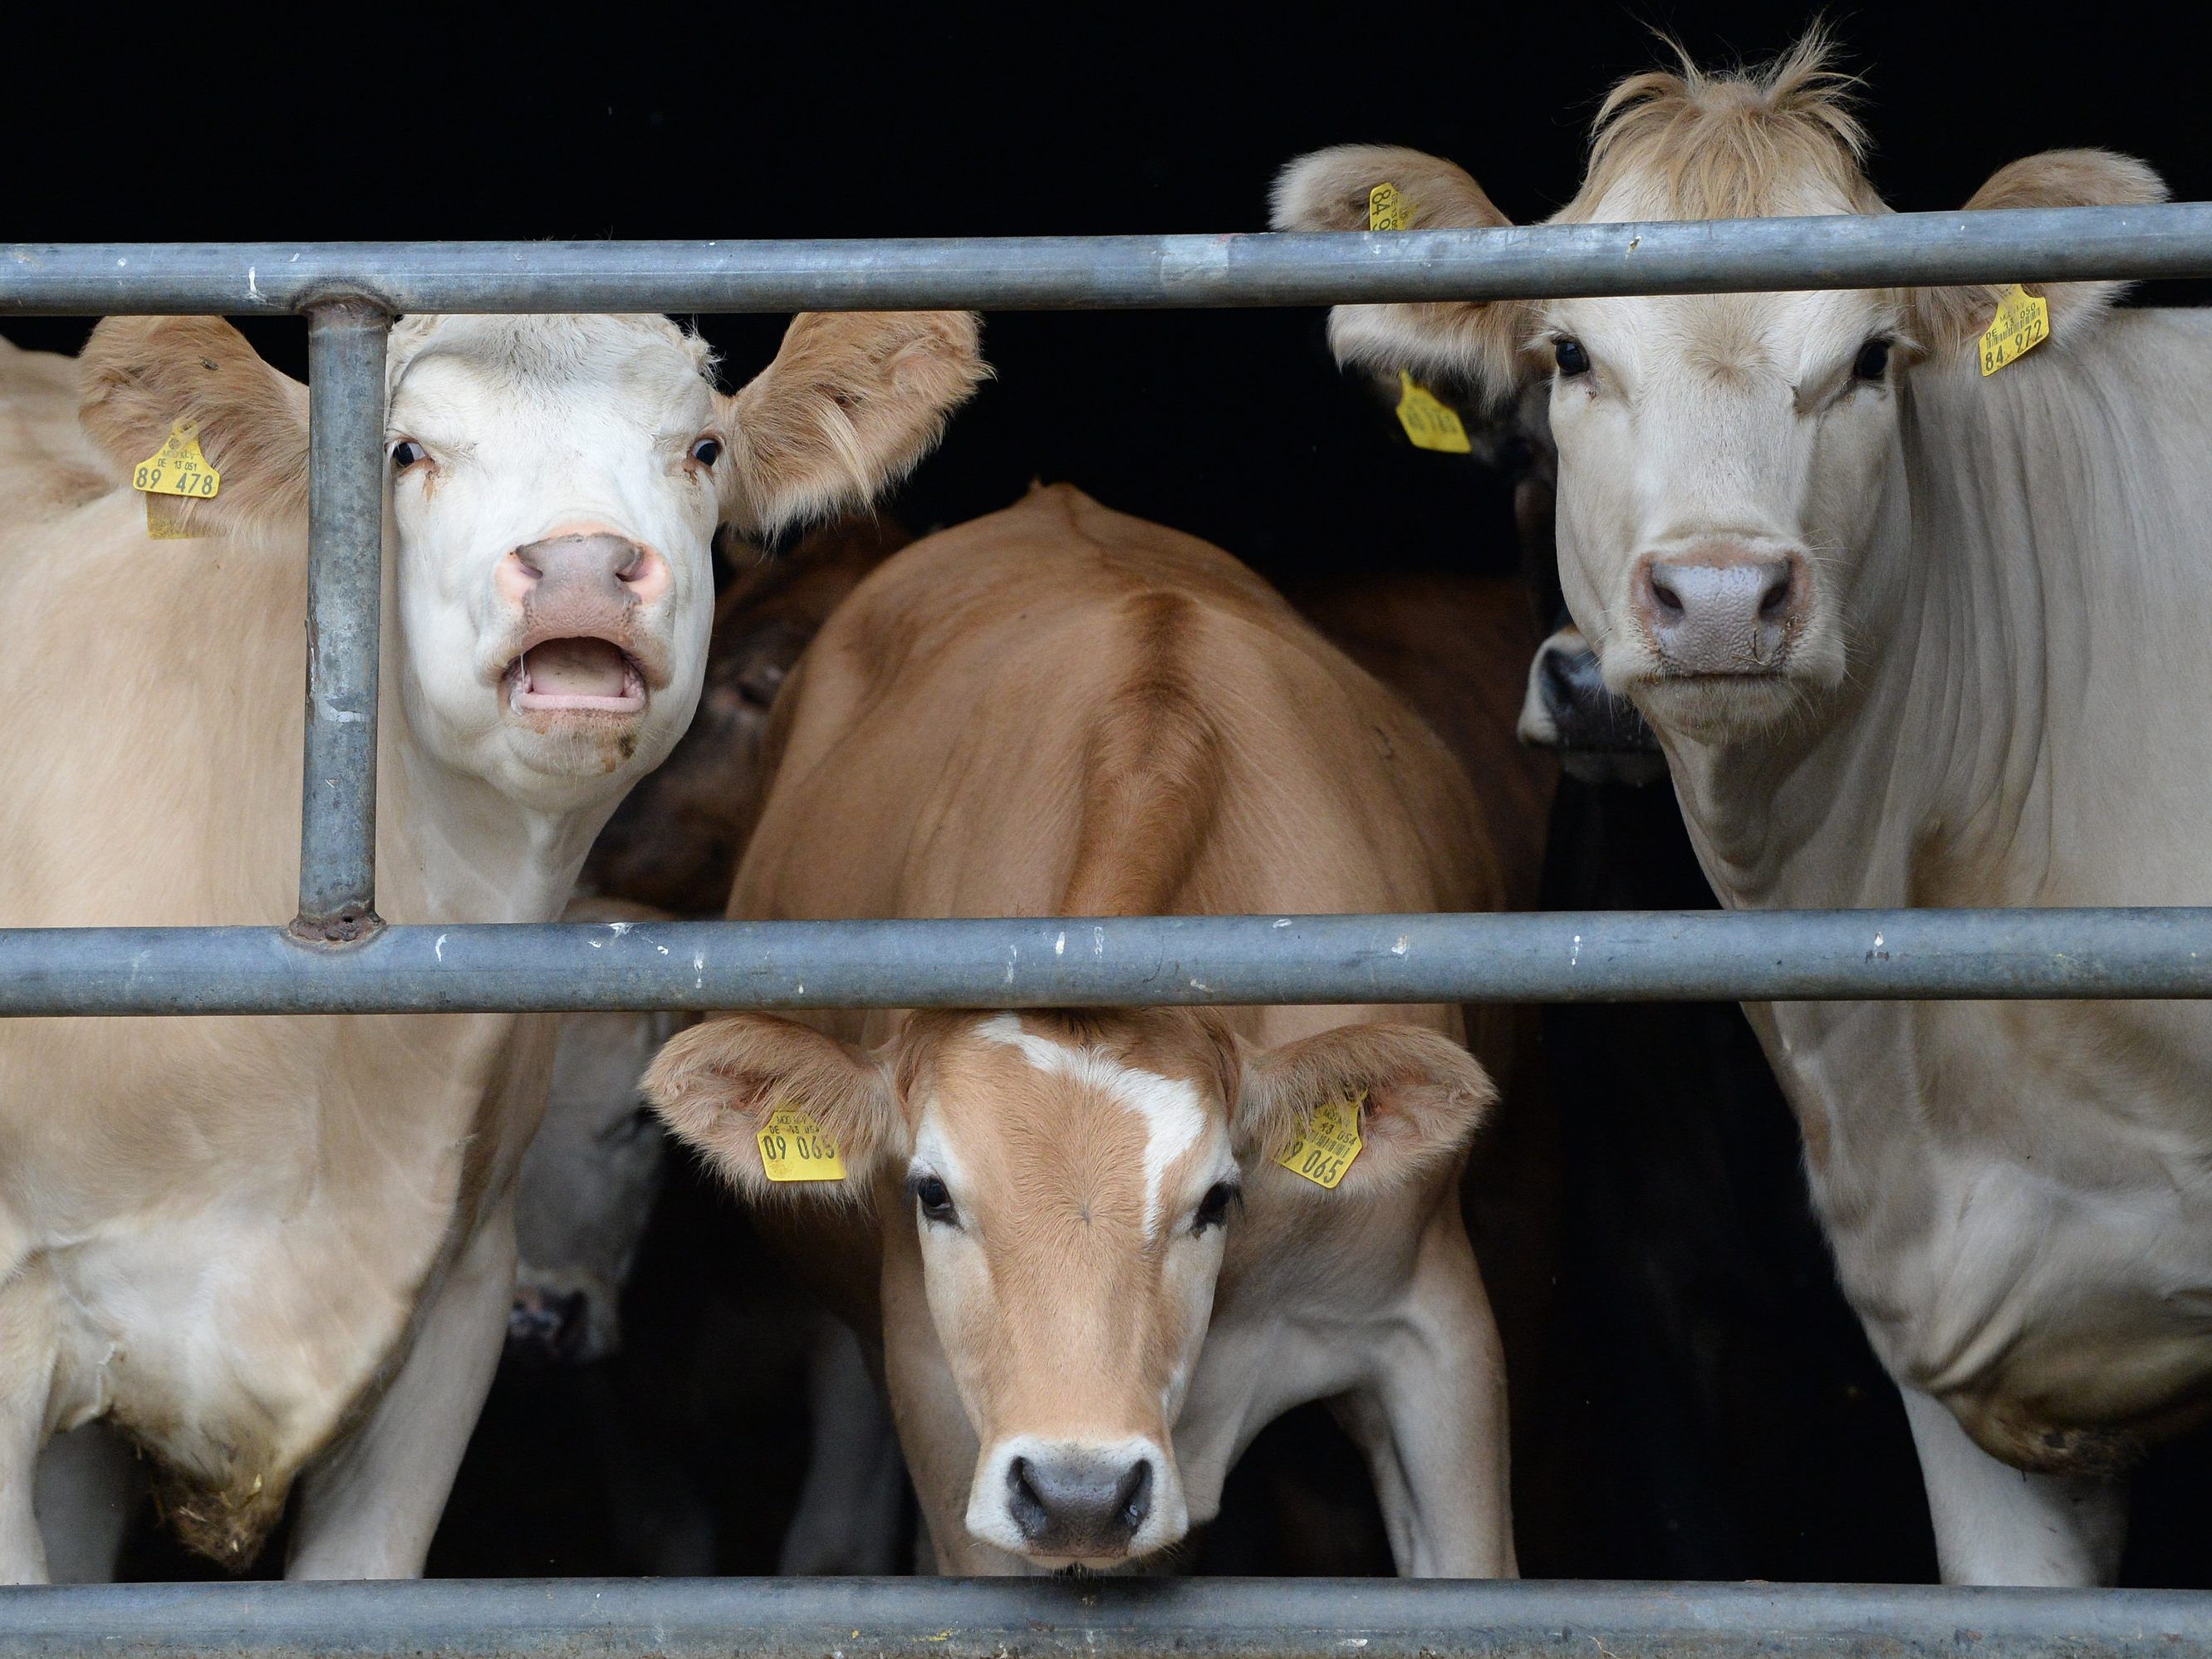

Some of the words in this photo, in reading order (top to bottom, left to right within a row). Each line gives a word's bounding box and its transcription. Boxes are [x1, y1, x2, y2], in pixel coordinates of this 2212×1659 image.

[1372, 189, 1391, 215] 84
[1985, 328, 1998, 341] DE
[2004, 318, 2014, 330] 13
[2019, 302, 2036, 318] 050
[1985, 345, 2004, 371] 84
[2015, 319, 2043, 353] 972
[157, 458, 167, 468] DE
[174, 460, 182, 469] 13
[136, 467, 162, 489] 89
[175, 472, 213, 495] 478
[769, 1126, 780, 1134] DE
[762, 1136, 787, 1160] 09
[1302, 1149, 1344, 1184] 065
